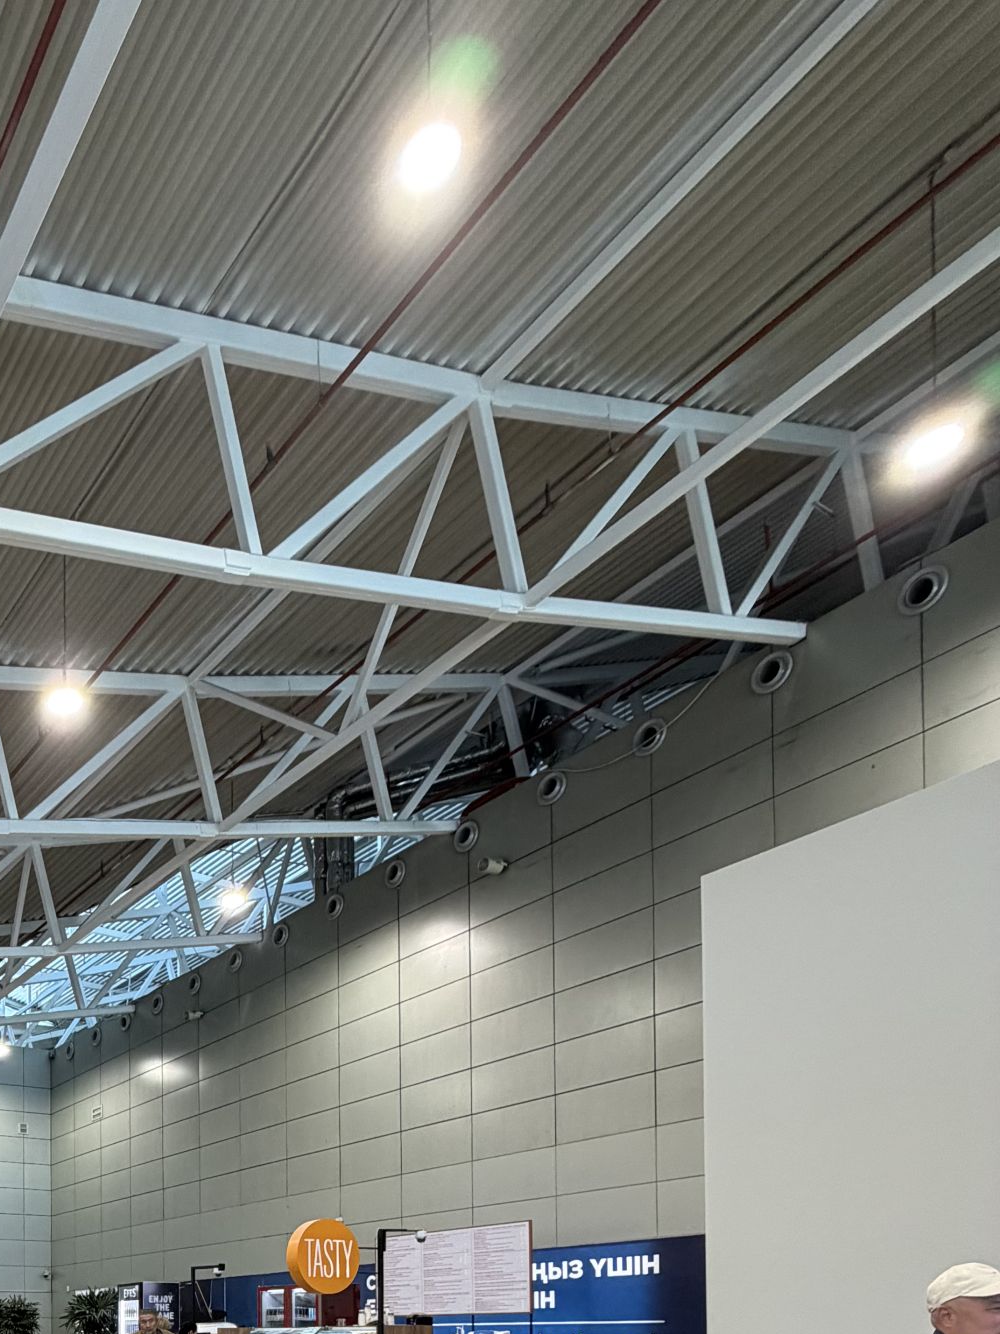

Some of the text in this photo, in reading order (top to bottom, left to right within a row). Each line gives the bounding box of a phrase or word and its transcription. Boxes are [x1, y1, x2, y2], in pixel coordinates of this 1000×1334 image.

[304, 1238, 353, 1279] TASTY
[123, 1288, 137, 1299] EFES
[148, 1294, 174, 1304] ENJOY
[155, 1303, 170, 1312] THE
[157, 1311, 175, 1320] AME
